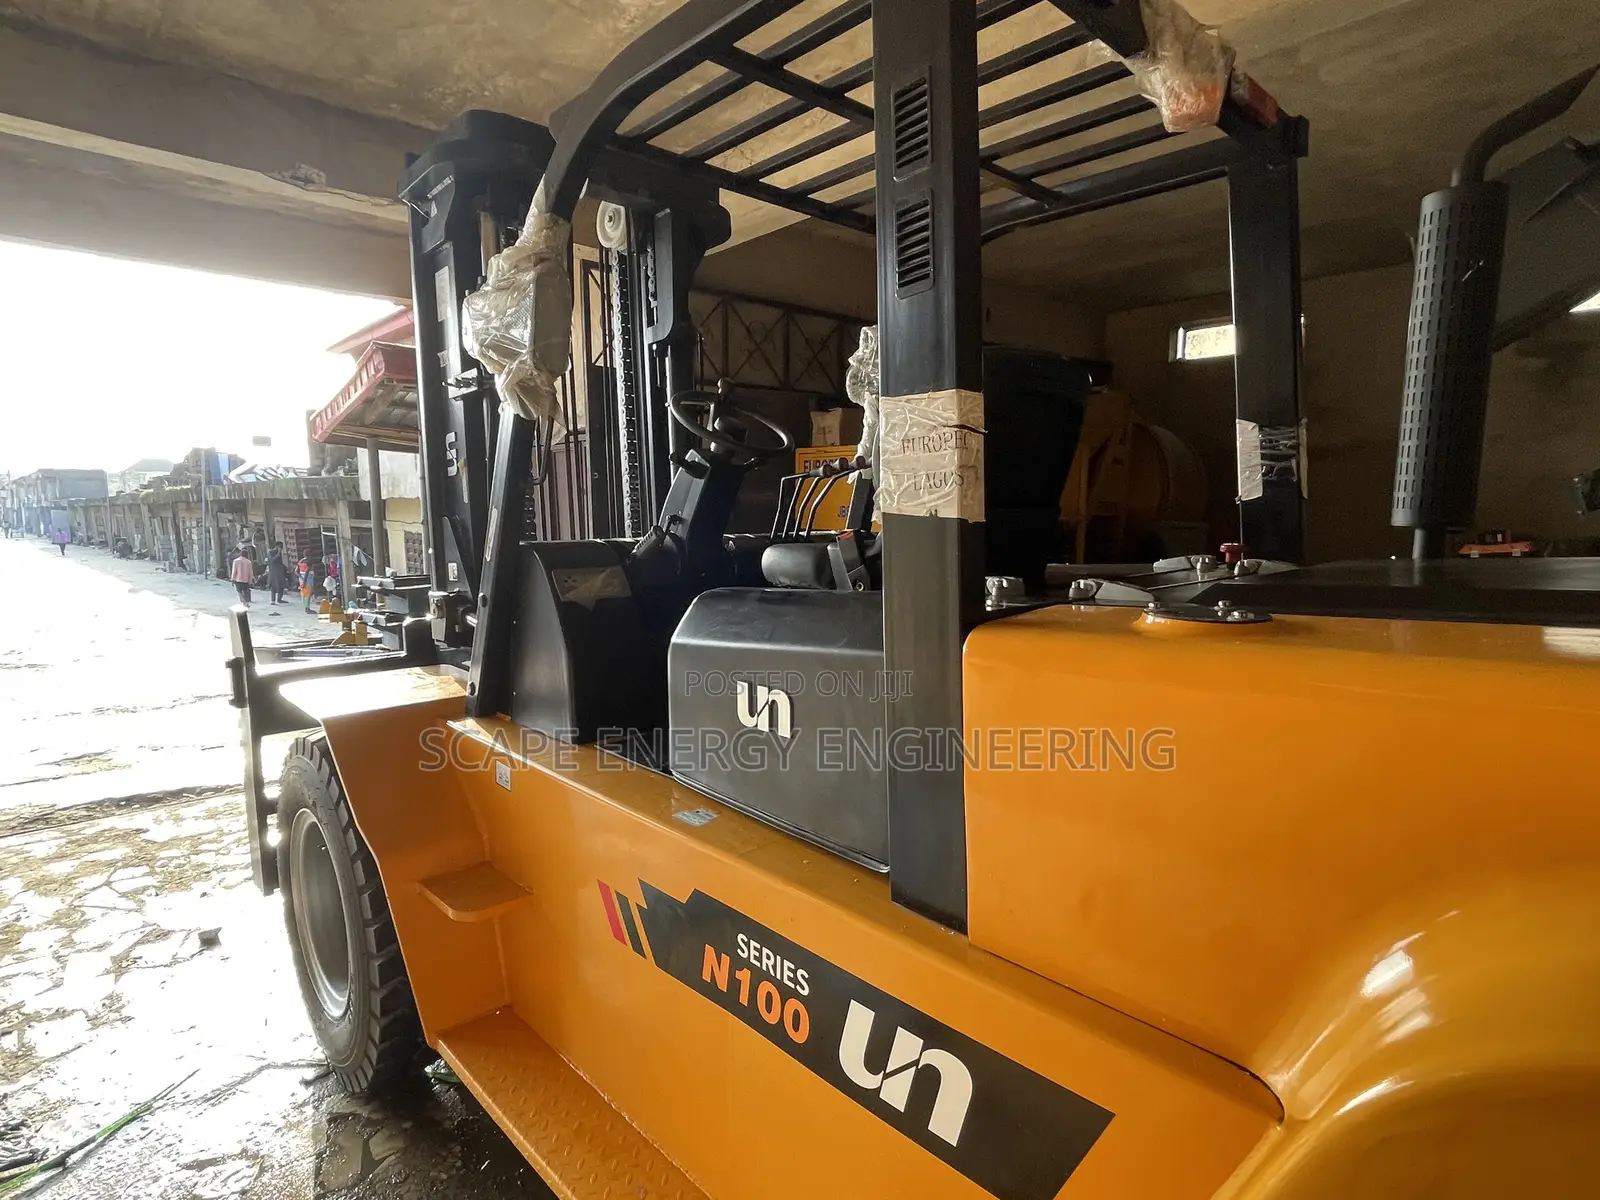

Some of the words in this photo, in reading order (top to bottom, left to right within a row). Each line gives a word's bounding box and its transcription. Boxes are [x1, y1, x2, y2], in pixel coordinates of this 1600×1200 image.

[913, 469, 965, 491] LAGOS
[701, 943, 811, 1044] N100
[736, 933, 810, 997] SERIES
